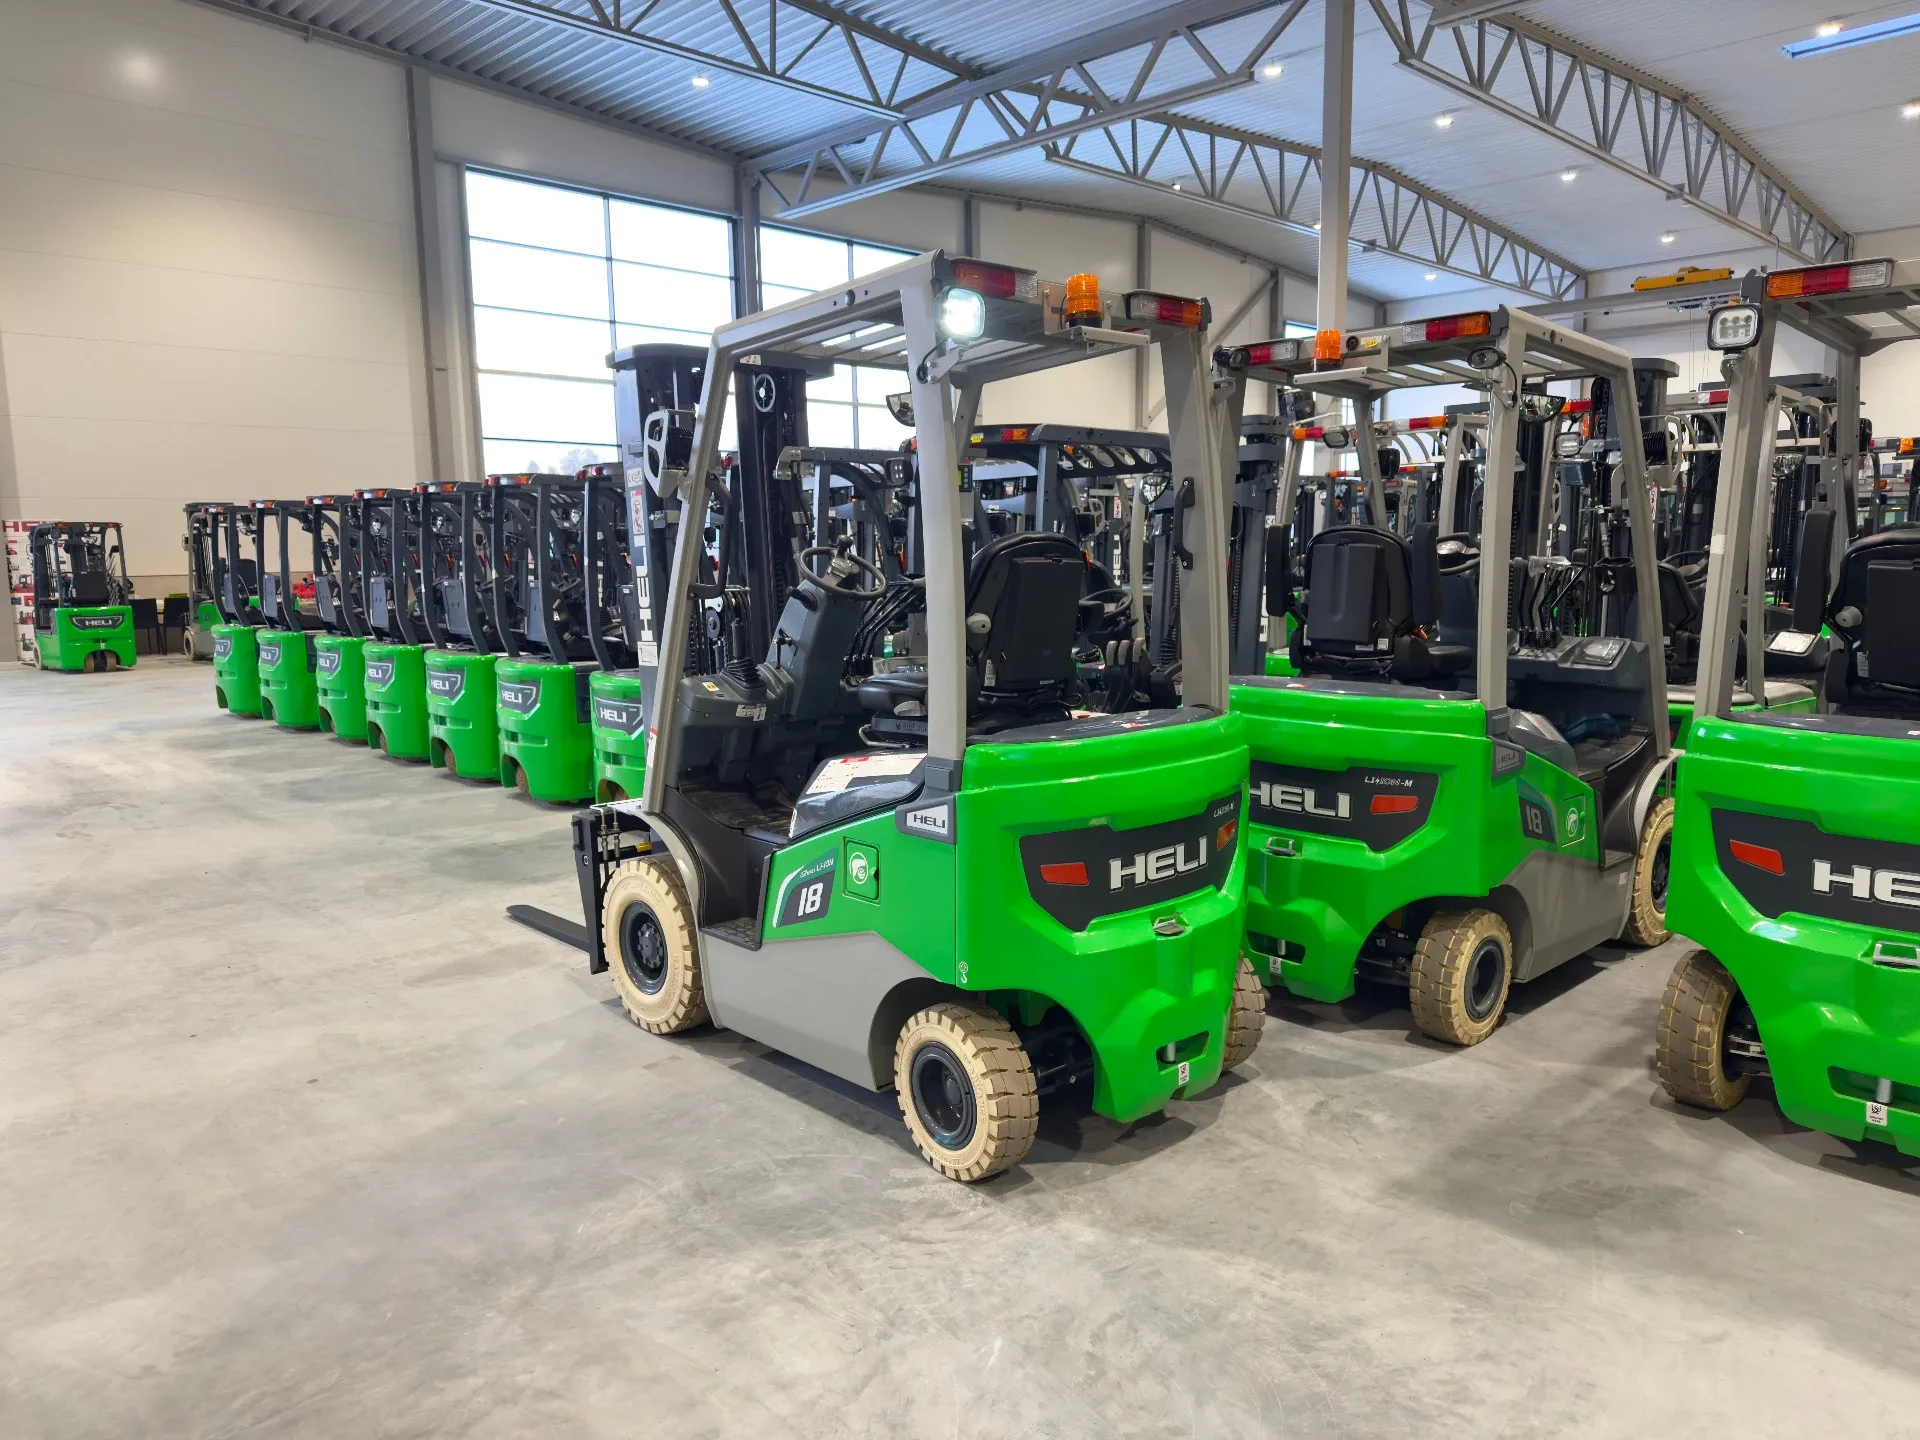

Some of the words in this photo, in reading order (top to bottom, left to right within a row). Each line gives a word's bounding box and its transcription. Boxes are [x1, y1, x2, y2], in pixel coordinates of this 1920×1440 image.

[634, 535, 653, 641] HELI
[85, 618, 113, 626] HELI
[430, 679, 449, 691] HELI
[501, 686, 523, 704] HELI
[599, 706, 627, 723] HELI
[913, 813, 946, 829] HELI
[1525, 805, 1543, 835] 18
[1109, 835, 1208, 891] HELI
[1812, 859, 1920, 908] HE
[797, 882, 824, 917] 18
